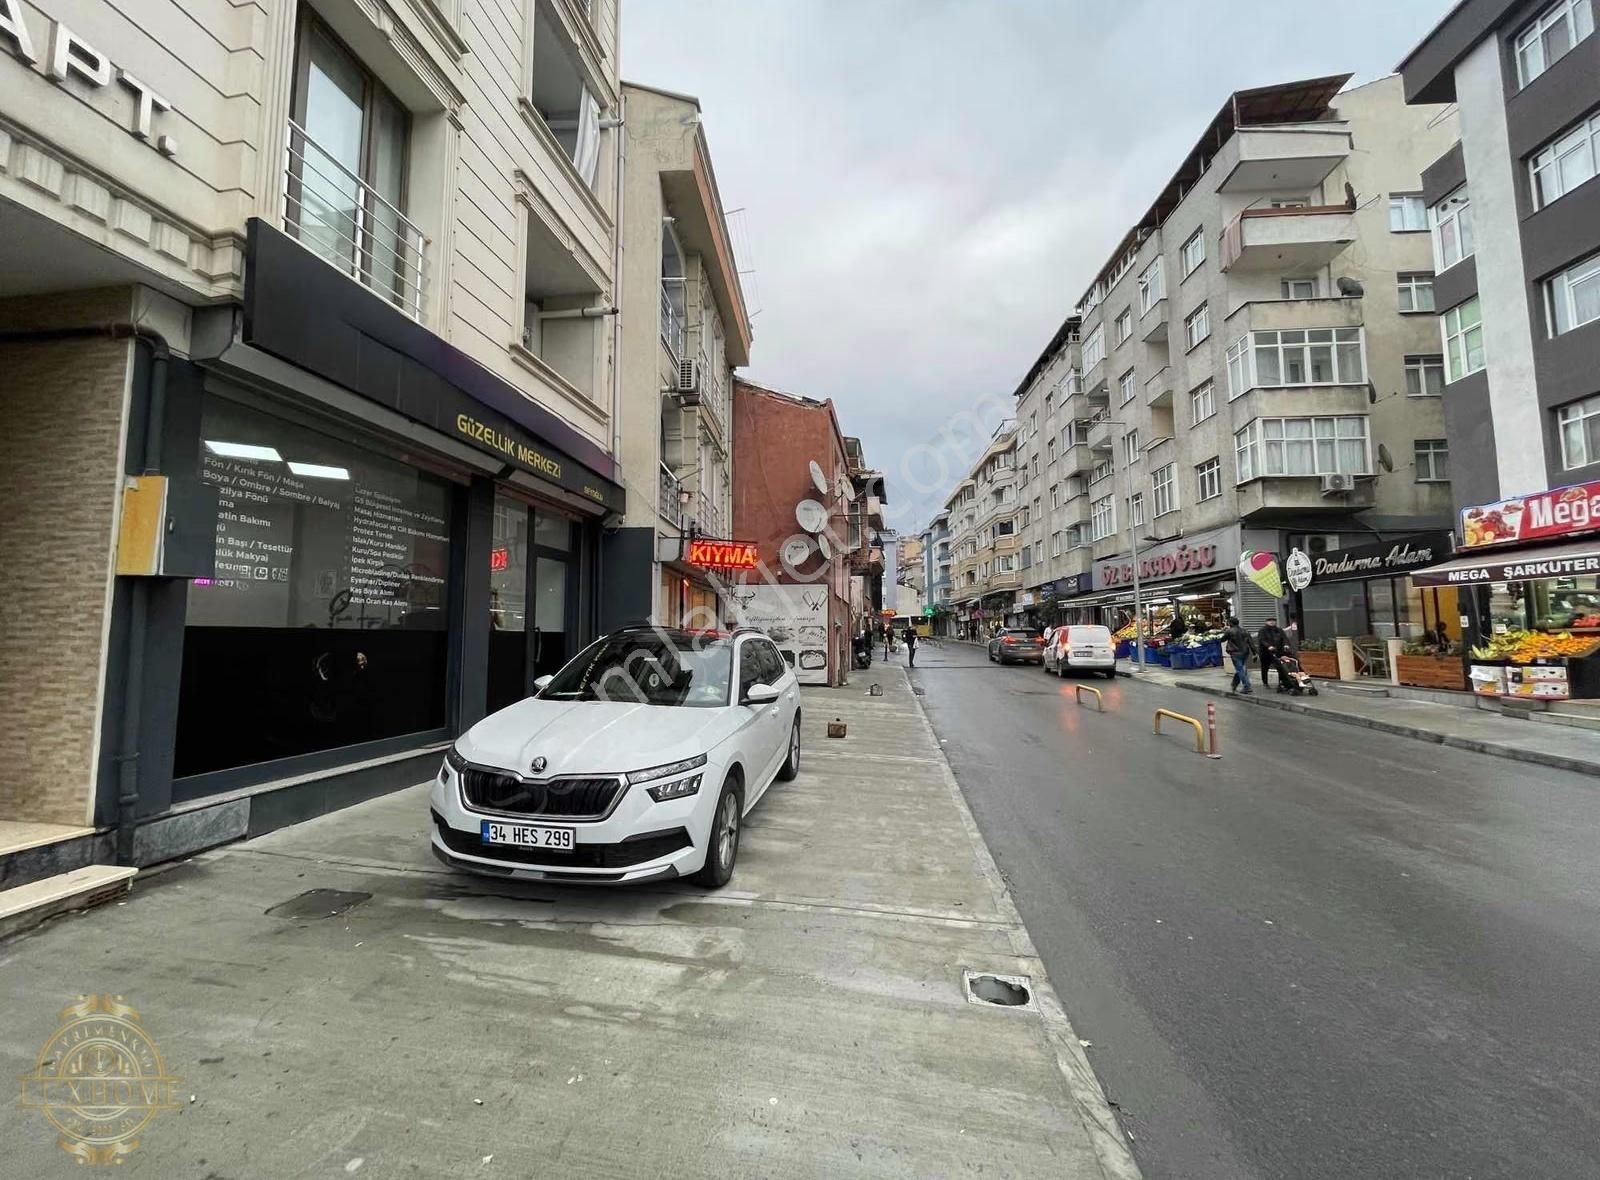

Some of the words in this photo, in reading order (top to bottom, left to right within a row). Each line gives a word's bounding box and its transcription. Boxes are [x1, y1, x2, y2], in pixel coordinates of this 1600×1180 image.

[517, 444, 561, 479] MERKEZİ
[203, 470, 229, 483] Boya
[239, 478, 271, 493] Ombre
[220, 487, 243, 498] zilya
[218, 511, 238, 521] atin
[692, 545, 755, 565] KIYMA
[1315, 553, 1382, 575] Dondurma
[1449, 568, 1490, 582] MEGA
[490, 825, 506, 841] 34
[513, 827, 538, 844] HES
[544, 830, 570, 847] 299
